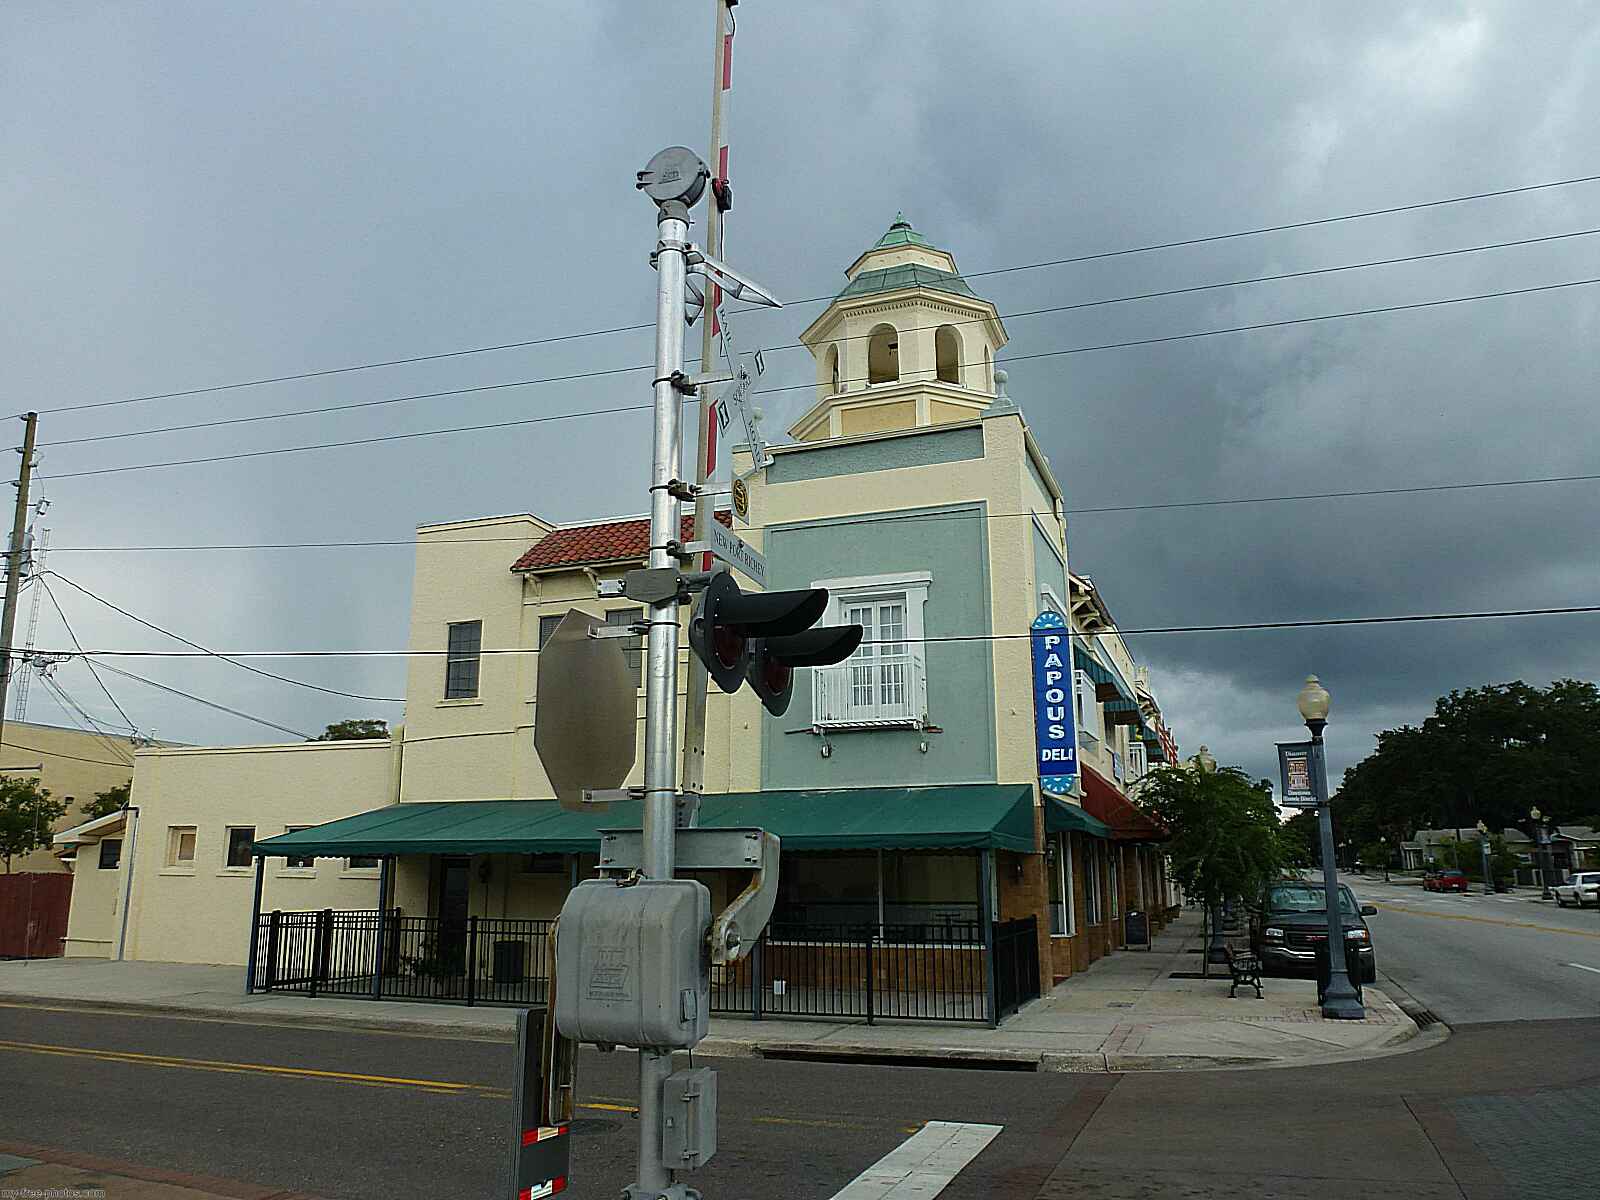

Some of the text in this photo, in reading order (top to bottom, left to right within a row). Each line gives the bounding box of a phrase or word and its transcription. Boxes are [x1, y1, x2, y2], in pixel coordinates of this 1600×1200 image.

[713, 528, 728, 551] NEW
[744, 552, 766, 577] RICHEY
[1044, 635, 1065, 739] PAPOUS
[1041, 748, 1074, 762] DELI
